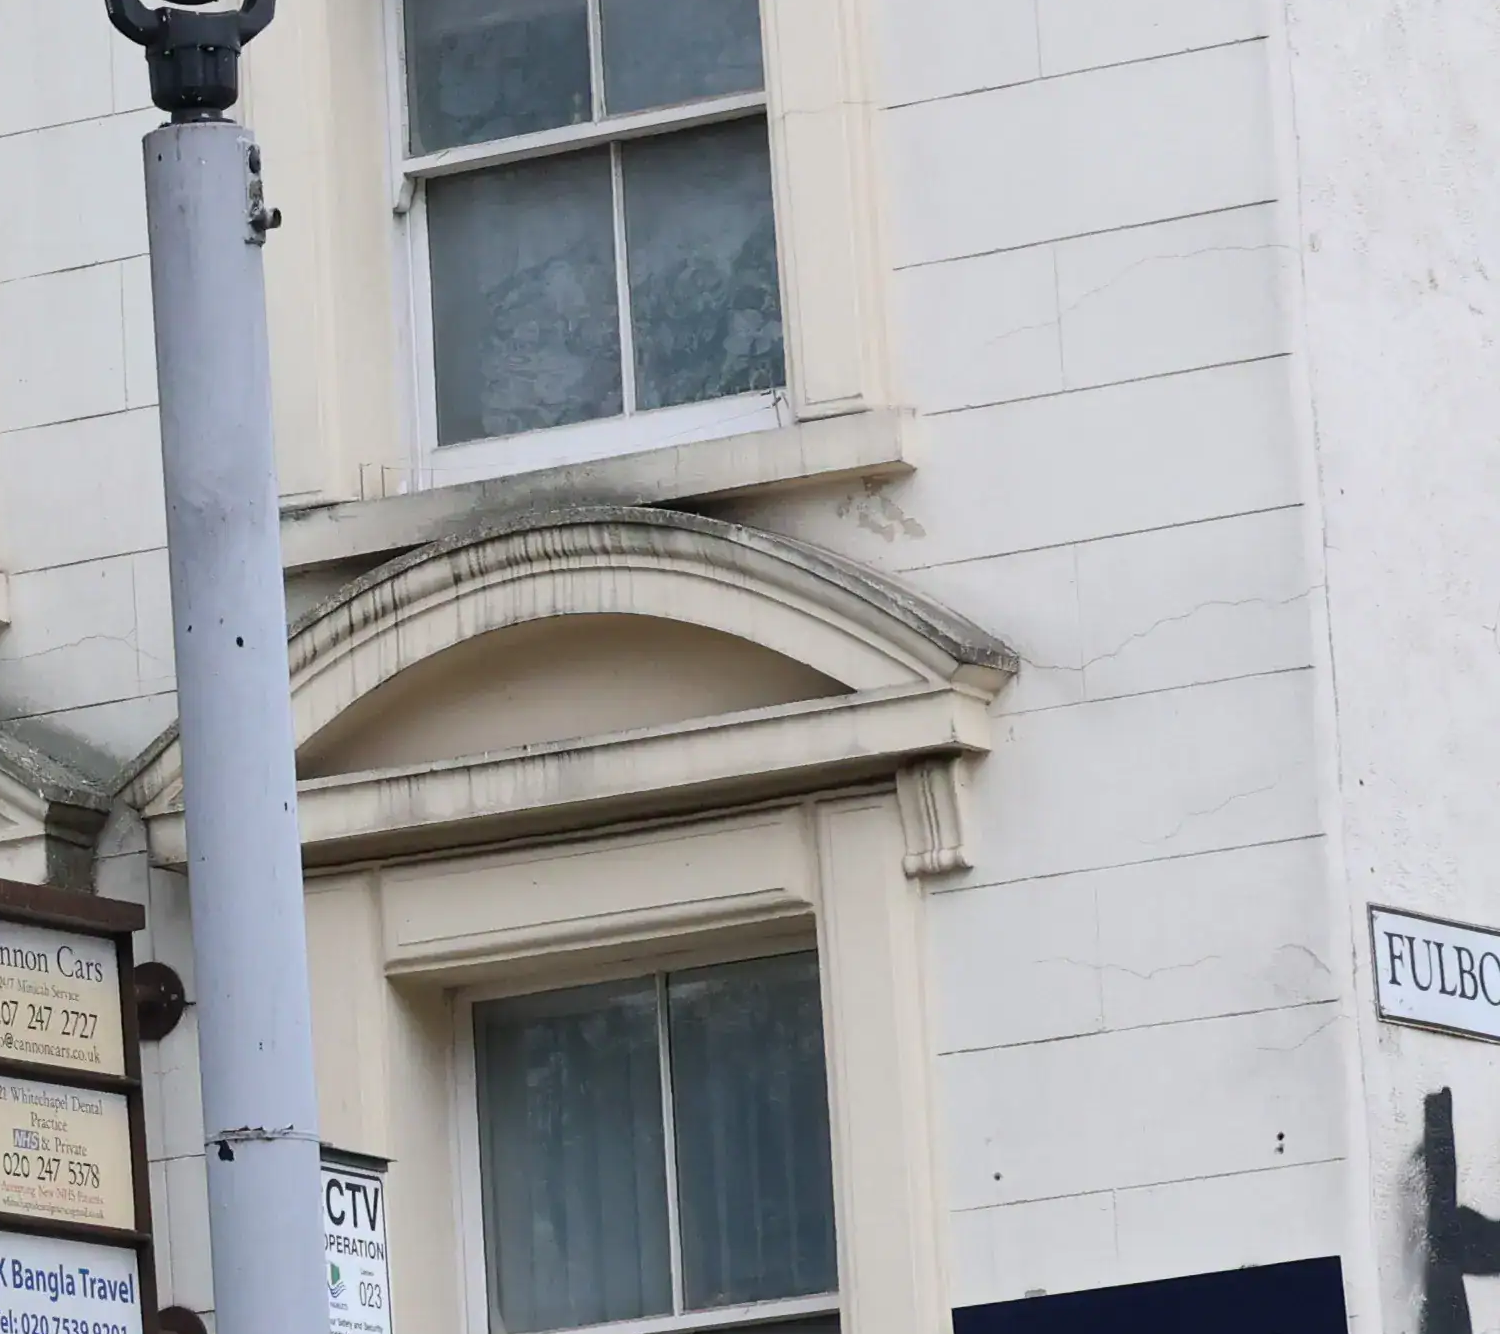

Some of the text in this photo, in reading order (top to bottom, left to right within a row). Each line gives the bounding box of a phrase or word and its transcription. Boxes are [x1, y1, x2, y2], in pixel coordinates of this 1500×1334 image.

[56, 945, 103, 983] Cars
[51, 985, 80, 1001] Service
[27, 1003, 52, 1031] 247
[61, 1010, 98, 1038] 2727
[11, 1086, 68, 1113] Whitechapel
[72, 1096, 103, 1115] Dental
[30, 1112, 68, 1132] Practice
[14, 1131, 88, 1157] NHS & Private
[2, 1153, 100, 1188] 020 247 5378
[11, 1258, 76, 1303] Bangla
[78, 1267, 135, 1304] Travel
[359, 1281, 382, 1309] 023
